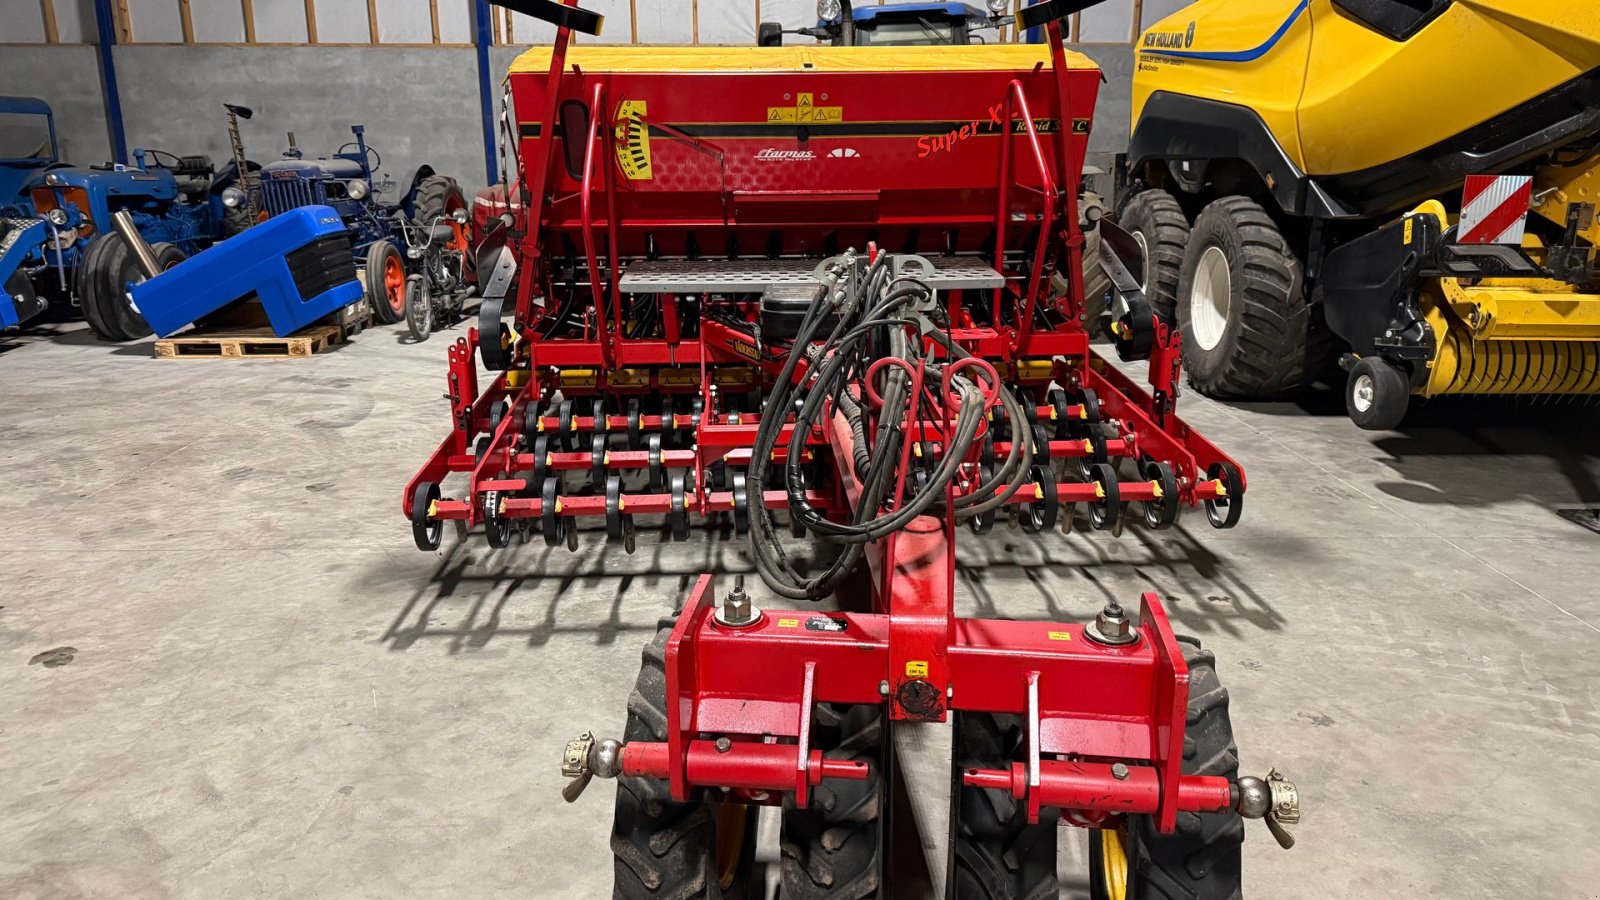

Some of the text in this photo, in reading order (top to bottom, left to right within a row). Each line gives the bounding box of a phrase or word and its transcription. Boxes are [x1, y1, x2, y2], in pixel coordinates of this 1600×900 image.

[1143, 32, 1184, 48] NEW HOLLAND
[917, 120, 980, 158] Super
[627, 169, 636, 177] 16
